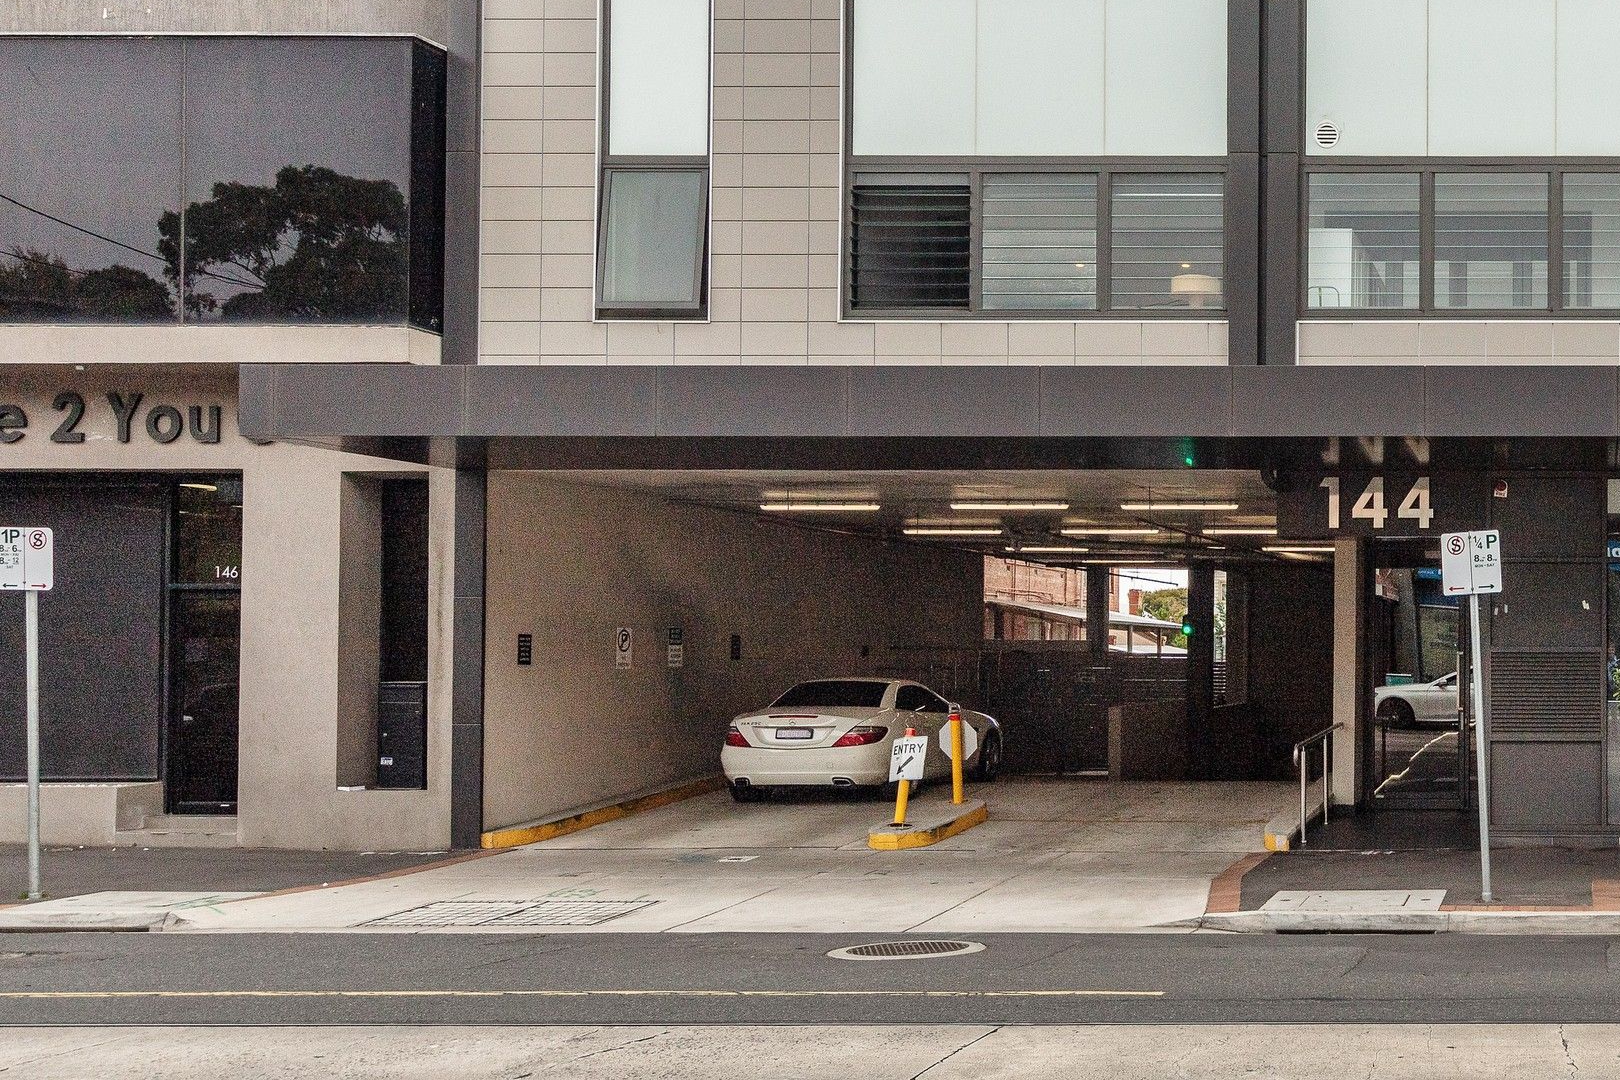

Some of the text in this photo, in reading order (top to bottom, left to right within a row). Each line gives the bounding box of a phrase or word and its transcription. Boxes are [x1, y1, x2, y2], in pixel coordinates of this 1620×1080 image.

[50, 391, 86, 444] 2
[106, 391, 222, 444] You
[1319, 476, 1434, 529] 144
[1, 529, 21, 544] 1P
[1486, 534, 1497, 549] P
[214, 566, 239, 579] 146
[893, 743, 924, 756] ENTRY
